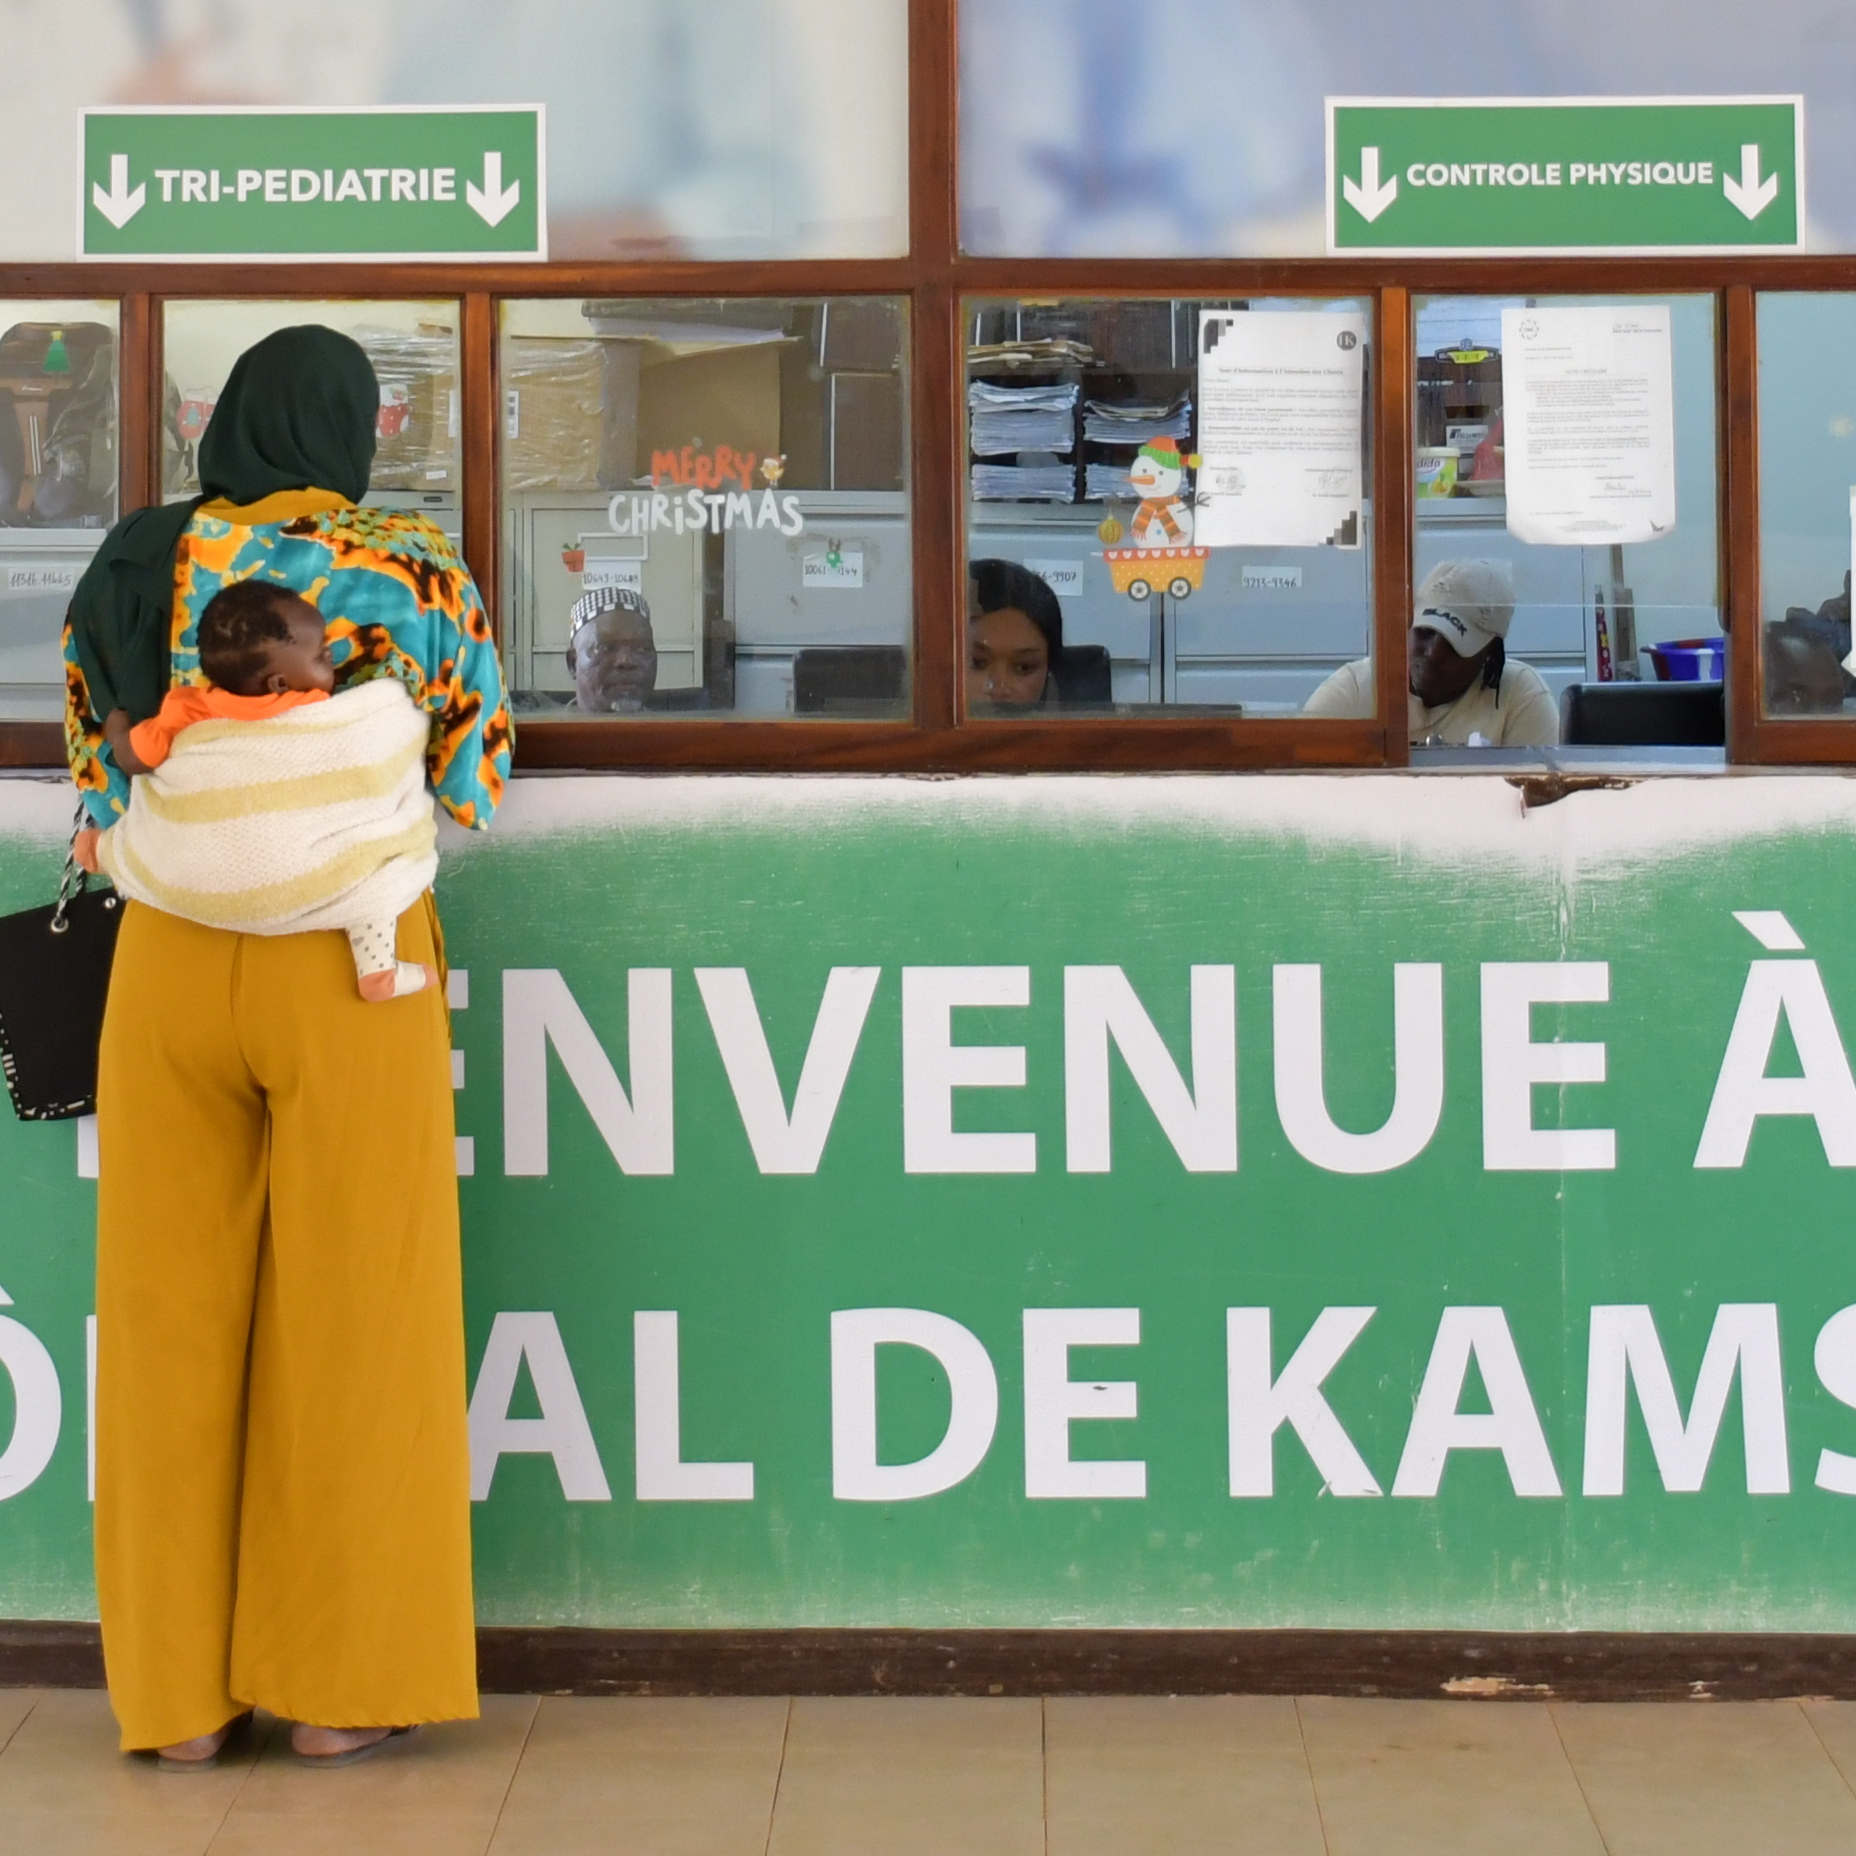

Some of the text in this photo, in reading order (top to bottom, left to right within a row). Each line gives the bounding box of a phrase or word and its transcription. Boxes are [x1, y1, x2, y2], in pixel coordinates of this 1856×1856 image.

[154, 167, 457, 202] TRI-PEDIATRIE
[1406, 162, 1713, 187] CONTROLE PHYSIQUE
[652, 445, 756, 490] MERRY
[78, 961, 1618, 1178] NVENUE
[830, 1307, 1147, 1501] DE
